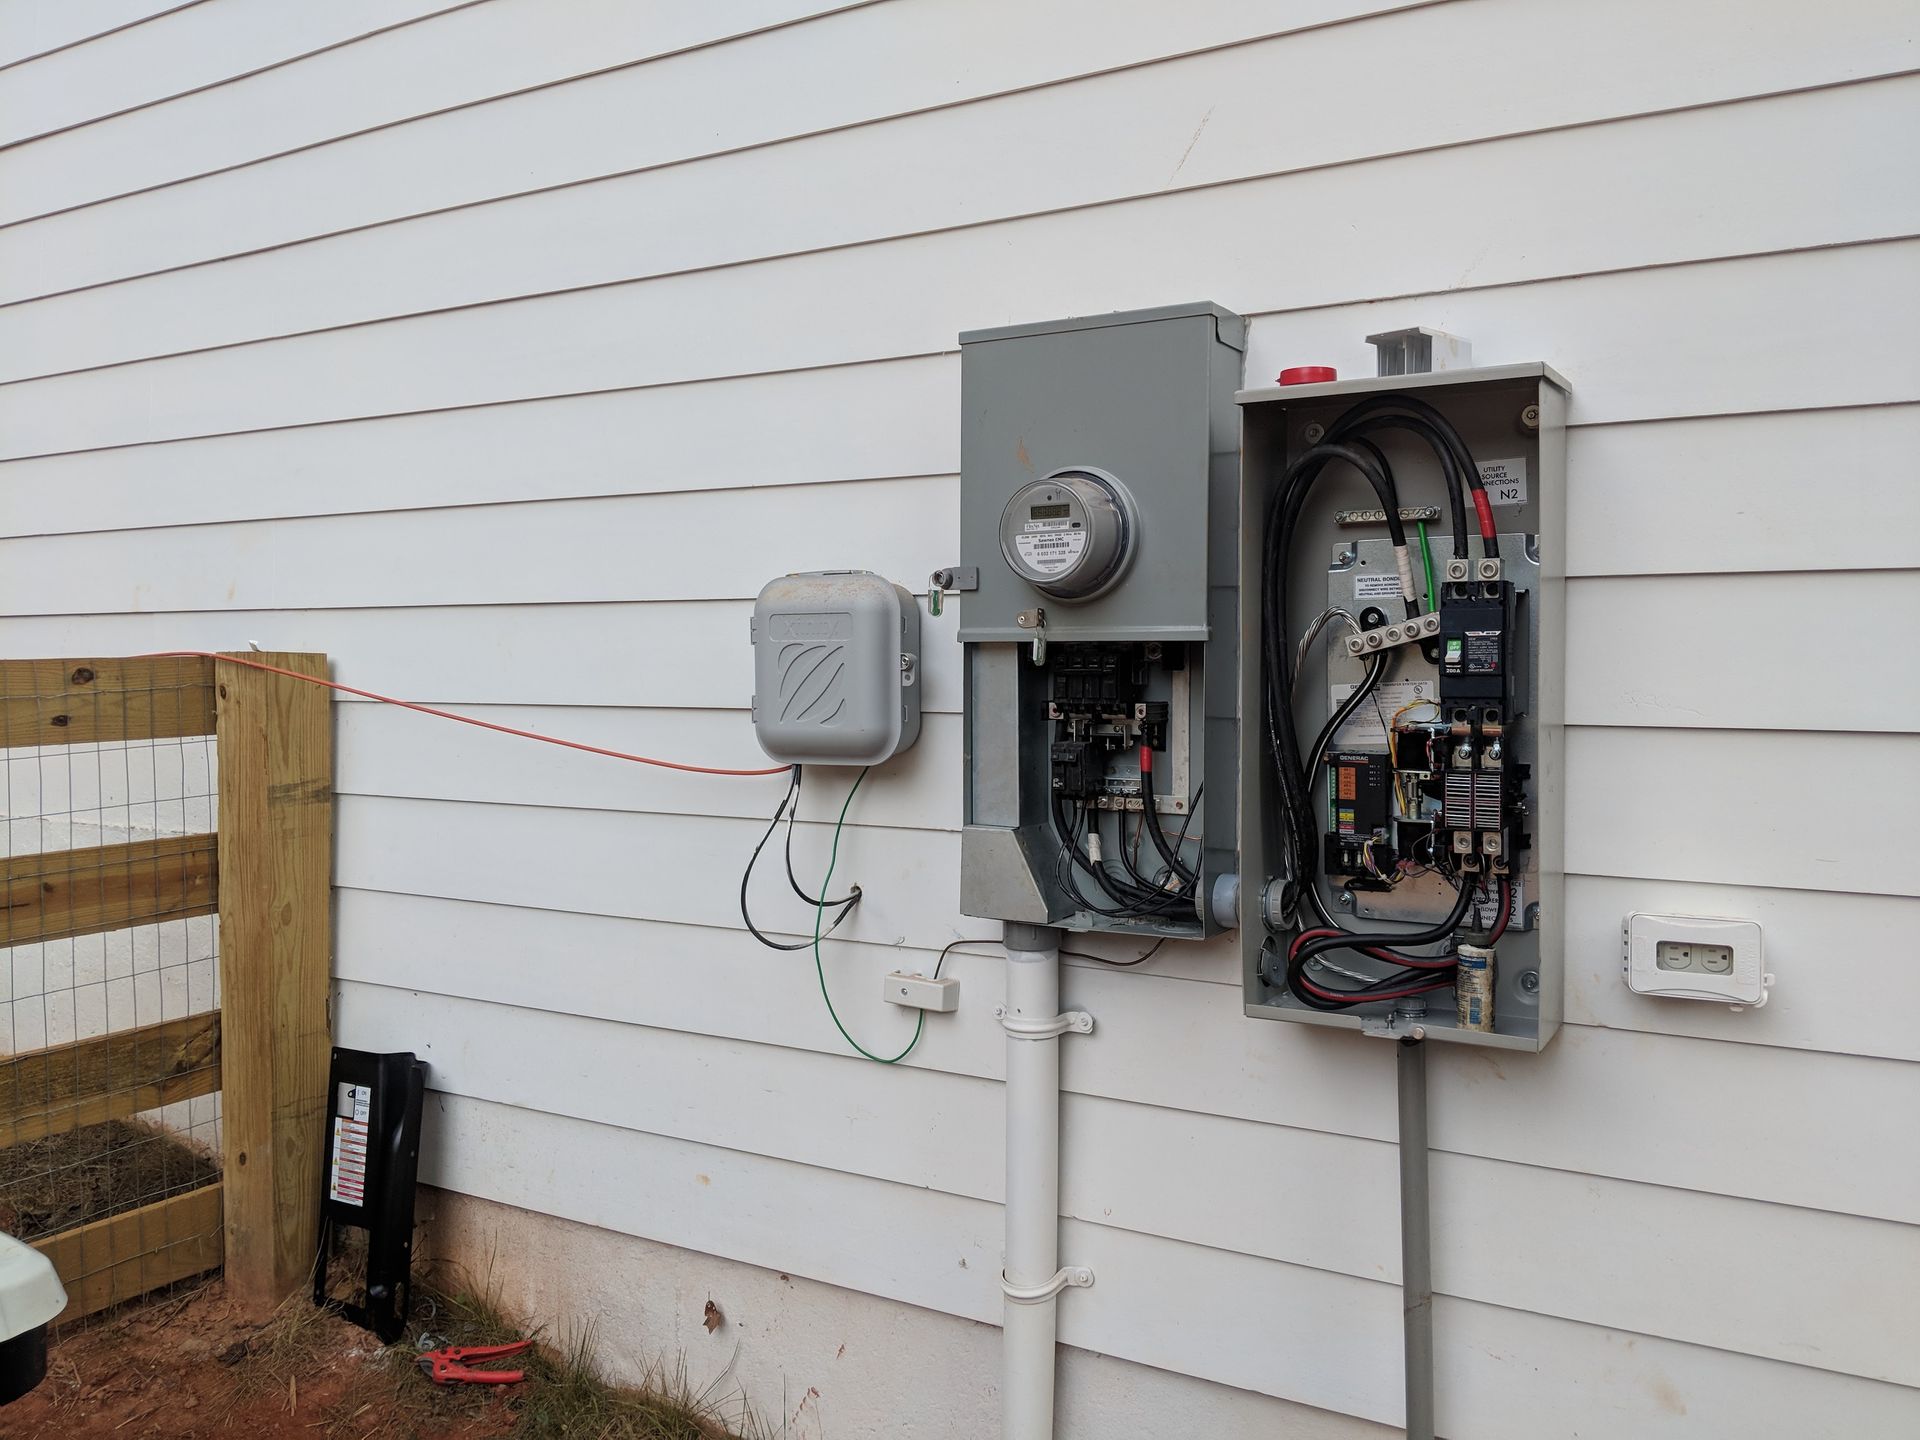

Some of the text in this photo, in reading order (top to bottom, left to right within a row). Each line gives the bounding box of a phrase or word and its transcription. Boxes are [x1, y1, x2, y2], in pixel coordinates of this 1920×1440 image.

[1483, 465, 1505, 473] UTILITY
[1481, 472, 1507, 480] SOURCE
[1481, 478, 1519, 486] NNECTIONS
[1500, 489, 1518, 500] N2
